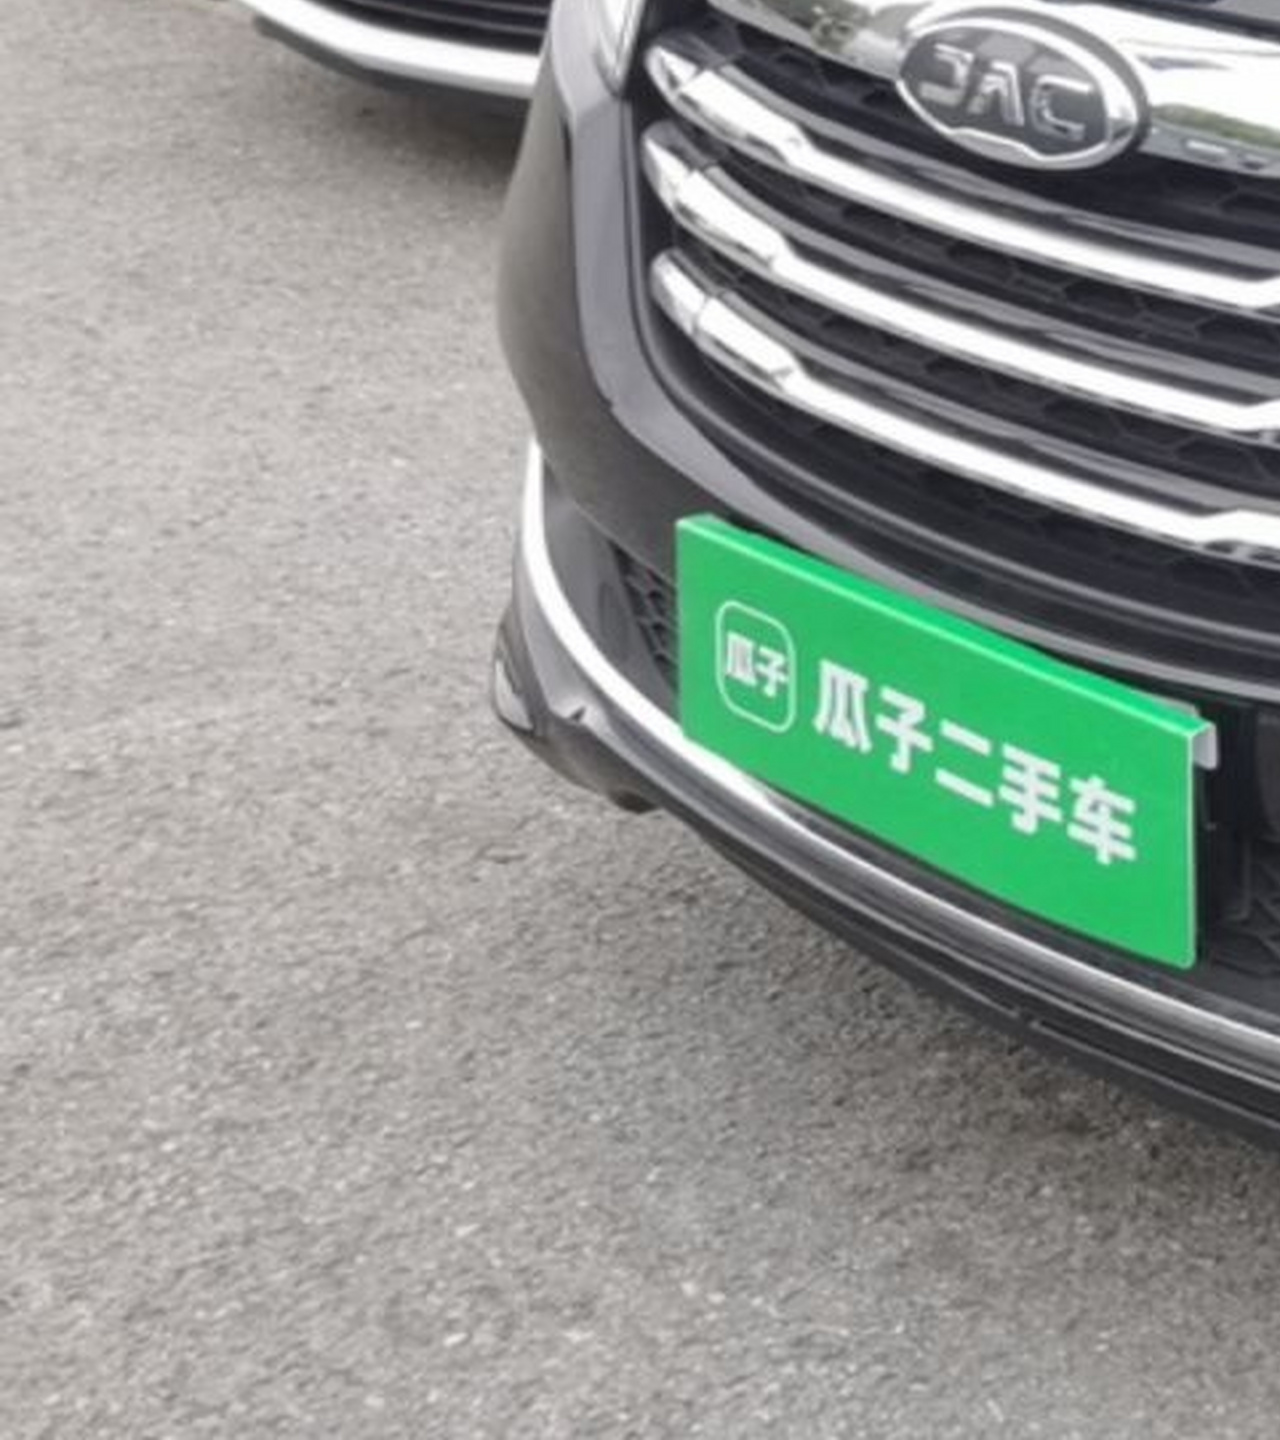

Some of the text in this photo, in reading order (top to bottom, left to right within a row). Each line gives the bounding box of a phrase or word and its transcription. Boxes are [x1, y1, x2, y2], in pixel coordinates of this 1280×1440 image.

[917, 42, 1096, 142] JAC
[725, 632, 788, 697] 瓜子
[813, 660, 1137, 865] 瓜子二手车
